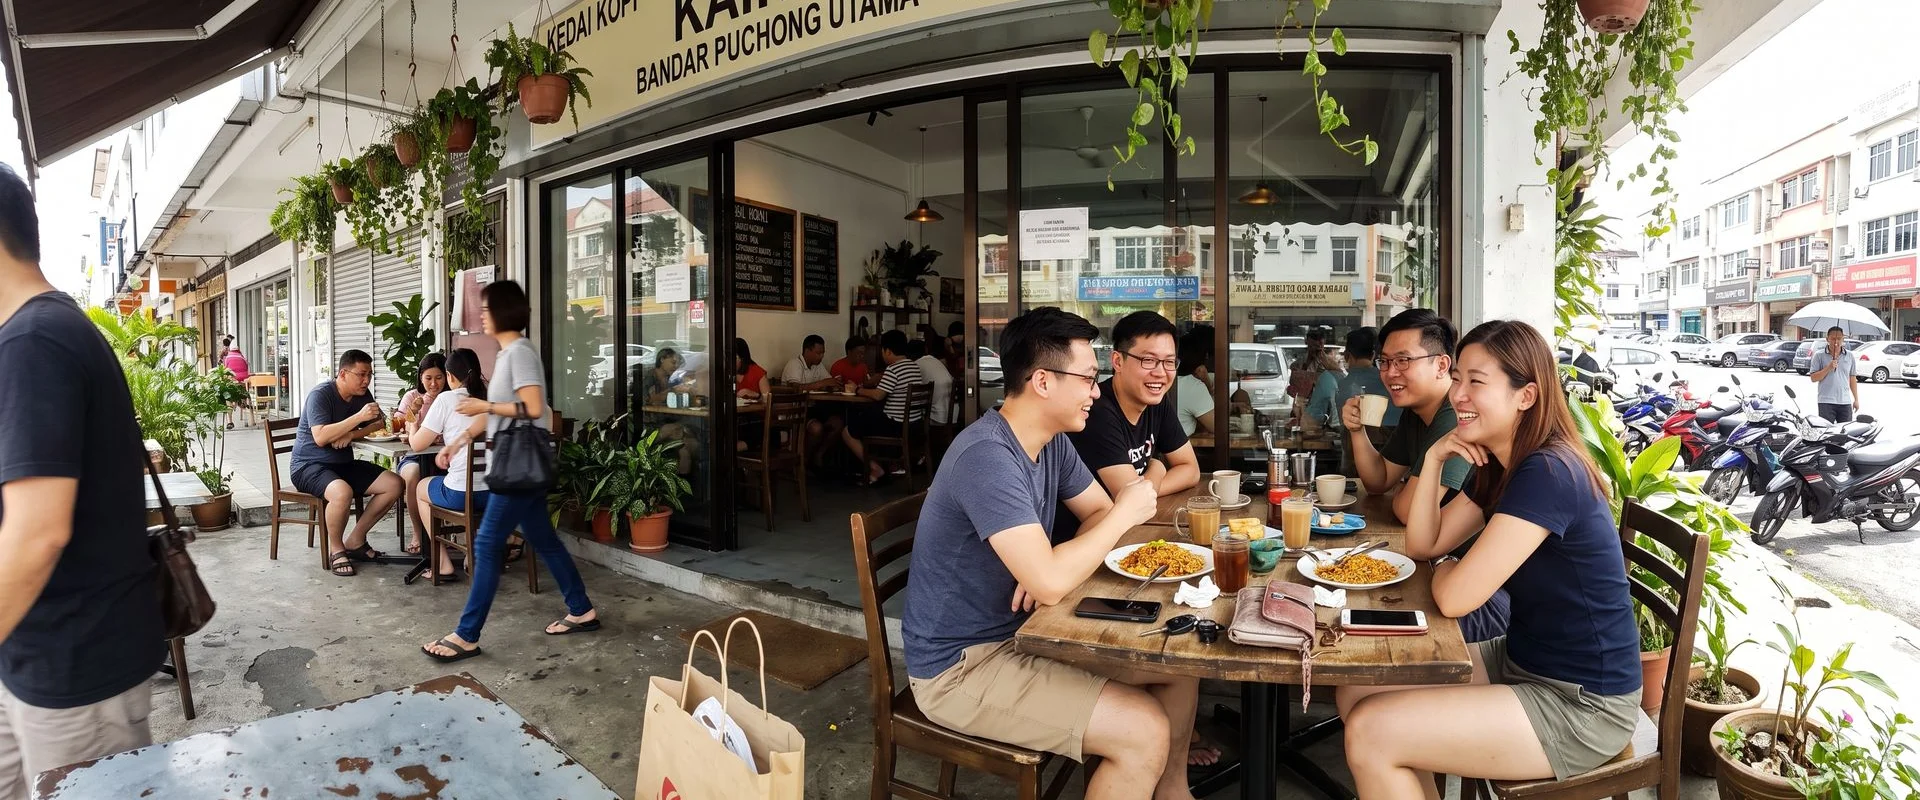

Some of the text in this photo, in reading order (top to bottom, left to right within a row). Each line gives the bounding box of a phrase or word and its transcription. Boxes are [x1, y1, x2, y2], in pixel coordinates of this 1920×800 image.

[547, 6, 591, 53] KEDAI
[637, 42, 709, 95] BANDAR
[714, 2, 821, 66] PUCHONG
